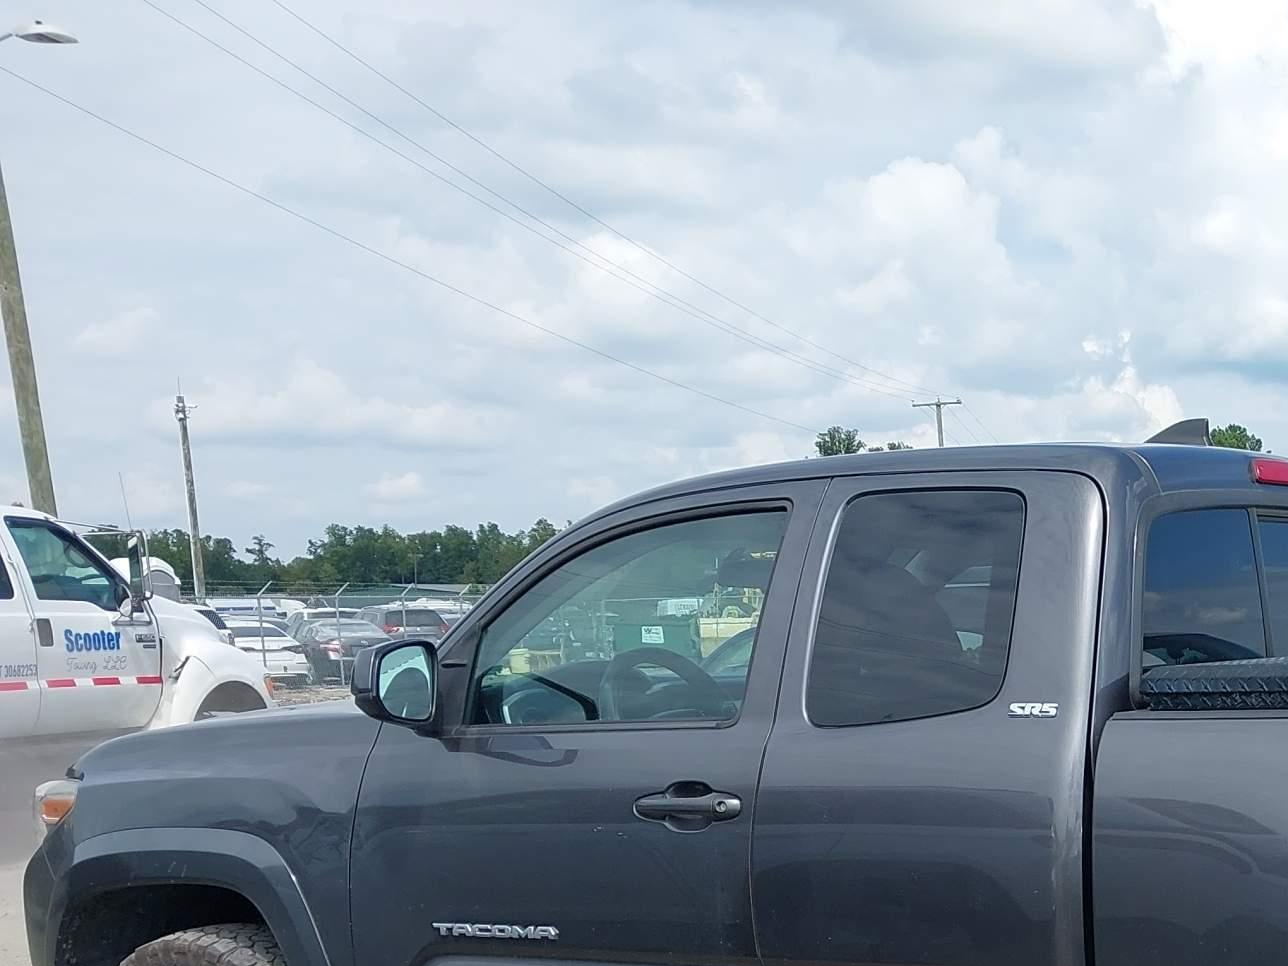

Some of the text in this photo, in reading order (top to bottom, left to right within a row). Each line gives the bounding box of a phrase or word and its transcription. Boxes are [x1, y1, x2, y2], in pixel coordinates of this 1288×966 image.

[64, 629, 121, 652] Scooter
[1008, 702, 1059, 718] SR5
[432, 922, 560, 940] TACOMA
